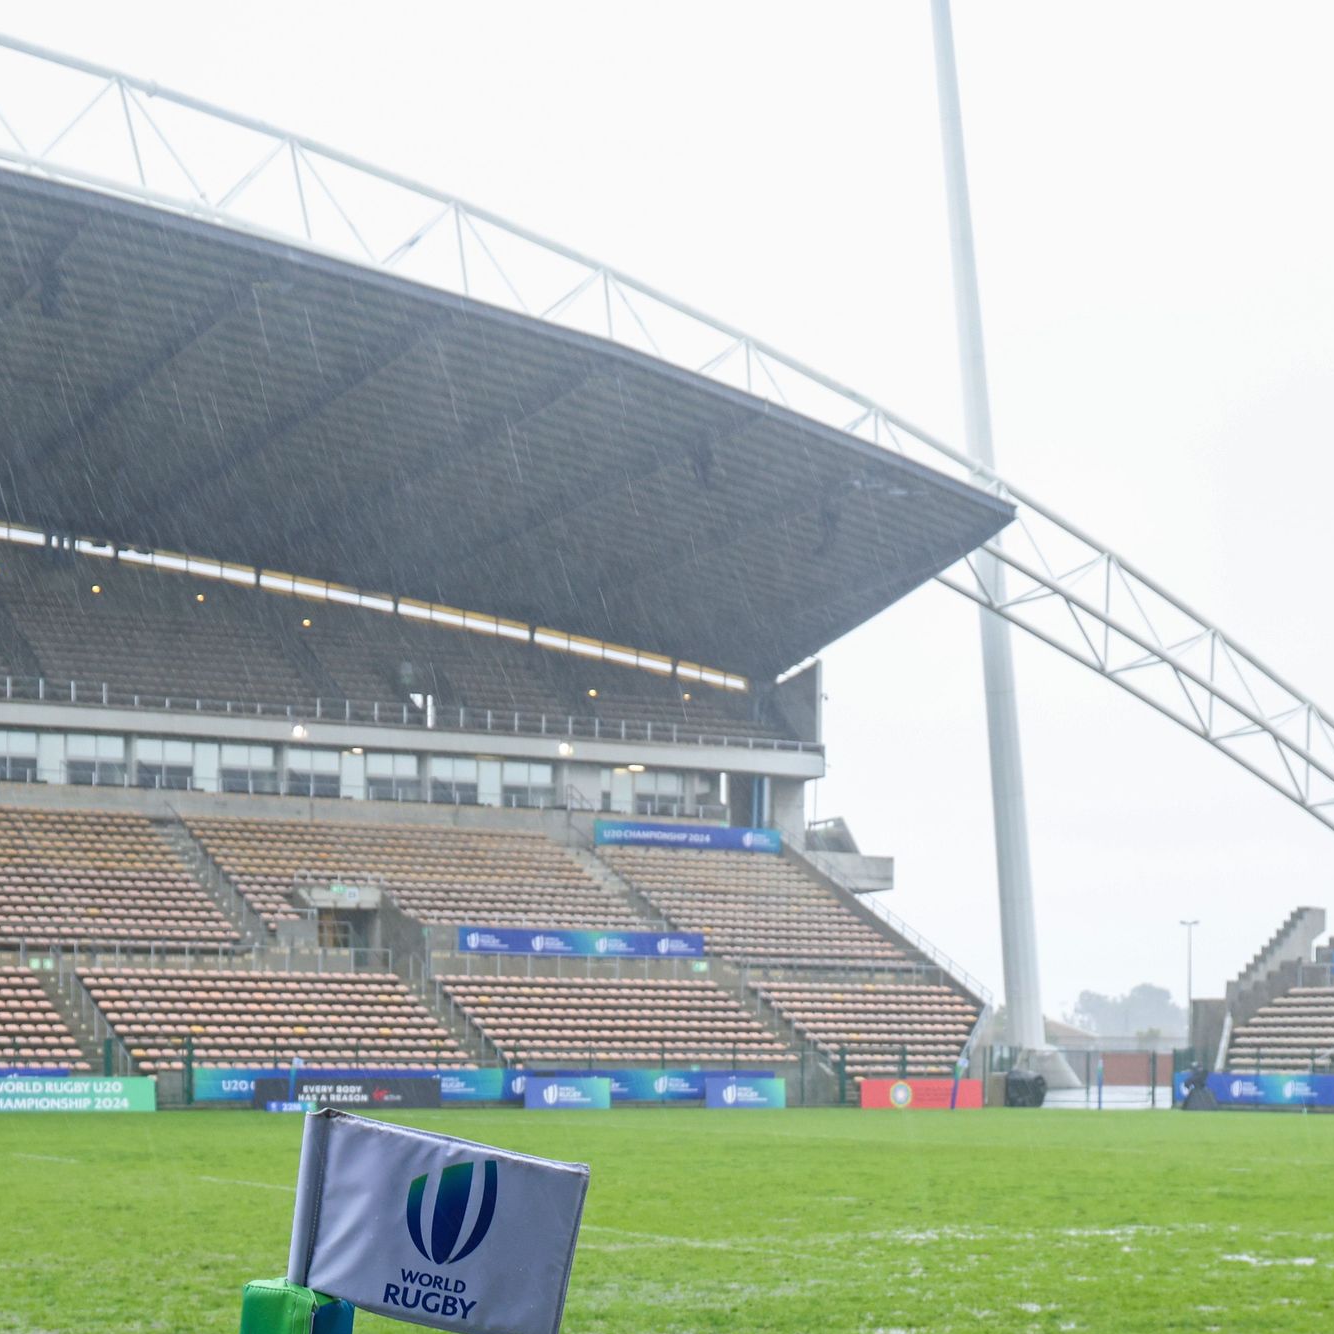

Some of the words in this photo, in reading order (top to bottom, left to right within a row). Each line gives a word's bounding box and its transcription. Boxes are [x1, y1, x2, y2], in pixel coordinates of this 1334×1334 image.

[45, 1081, 90, 1093] RUGBY
[93, 1081, 123, 1093] U20
[222, 1080, 249, 1091] U20
[302, 1085, 333, 1094] EVERY
[336, 1085, 362, 1094] BODY
[94, 1097, 130, 1110] 2024
[298, 1093, 317, 1102] HAS
[320, 1093, 328, 1102] A
[329, 1093, 369, 1102] REASON
[400, 1267, 466, 1294] WORLD
[382, 1283, 477, 1320] RUGBY
